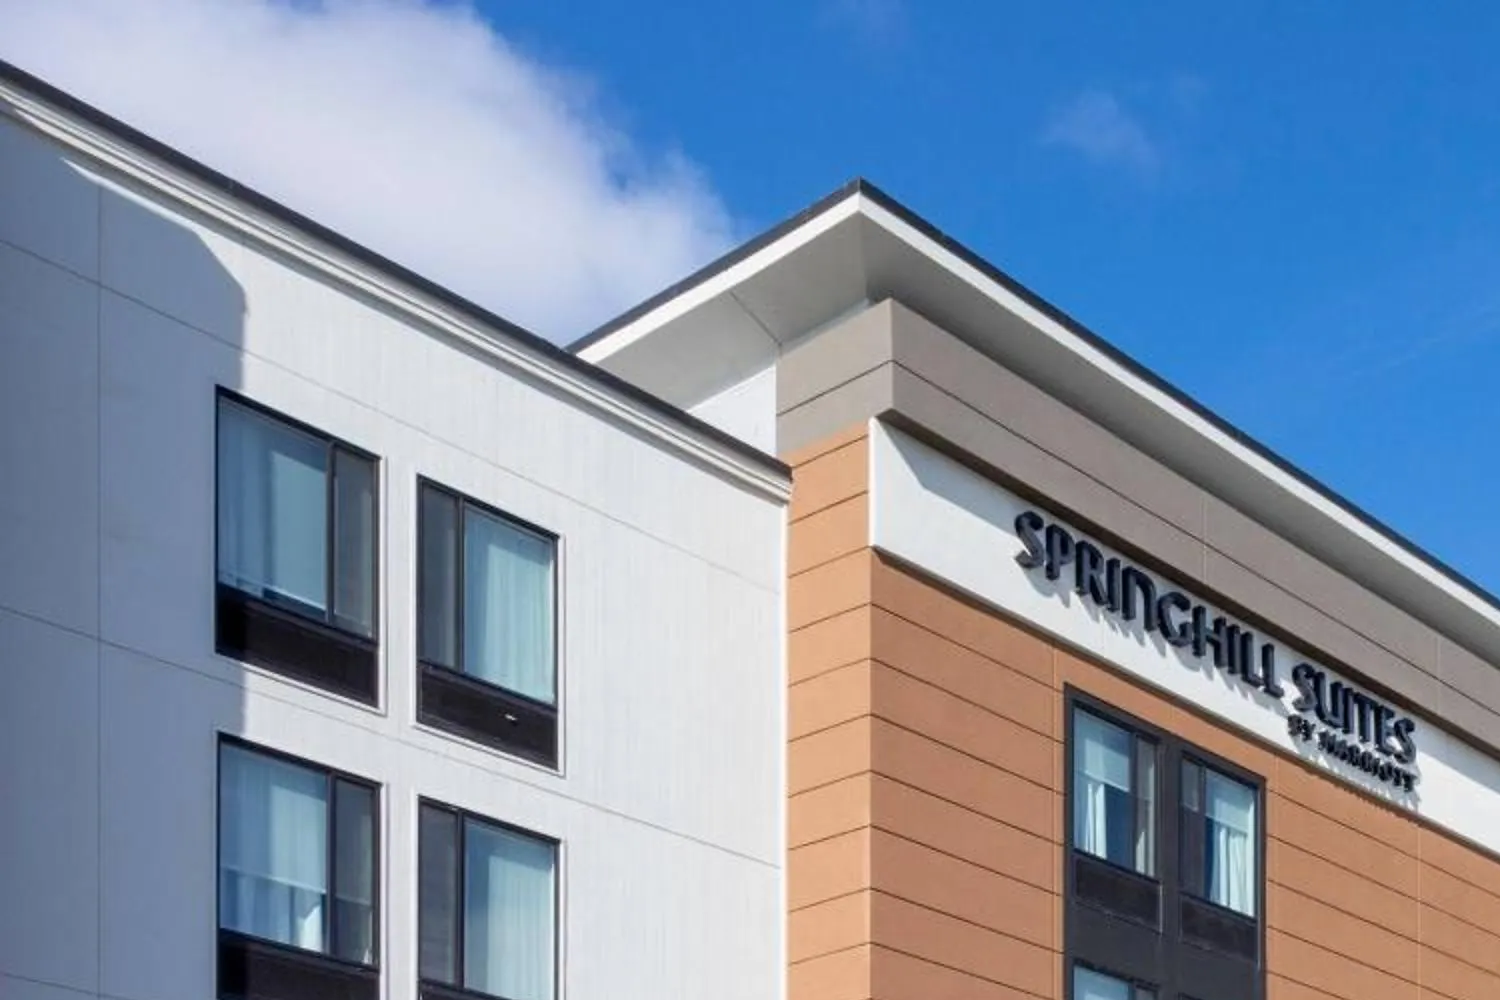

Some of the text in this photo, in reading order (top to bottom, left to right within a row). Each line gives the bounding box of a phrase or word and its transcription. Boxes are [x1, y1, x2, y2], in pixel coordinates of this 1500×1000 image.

[1014, 511, 1417, 764] SPRINGHILL SUITES
[1287, 714, 1418, 793] BY MARRIOTT
